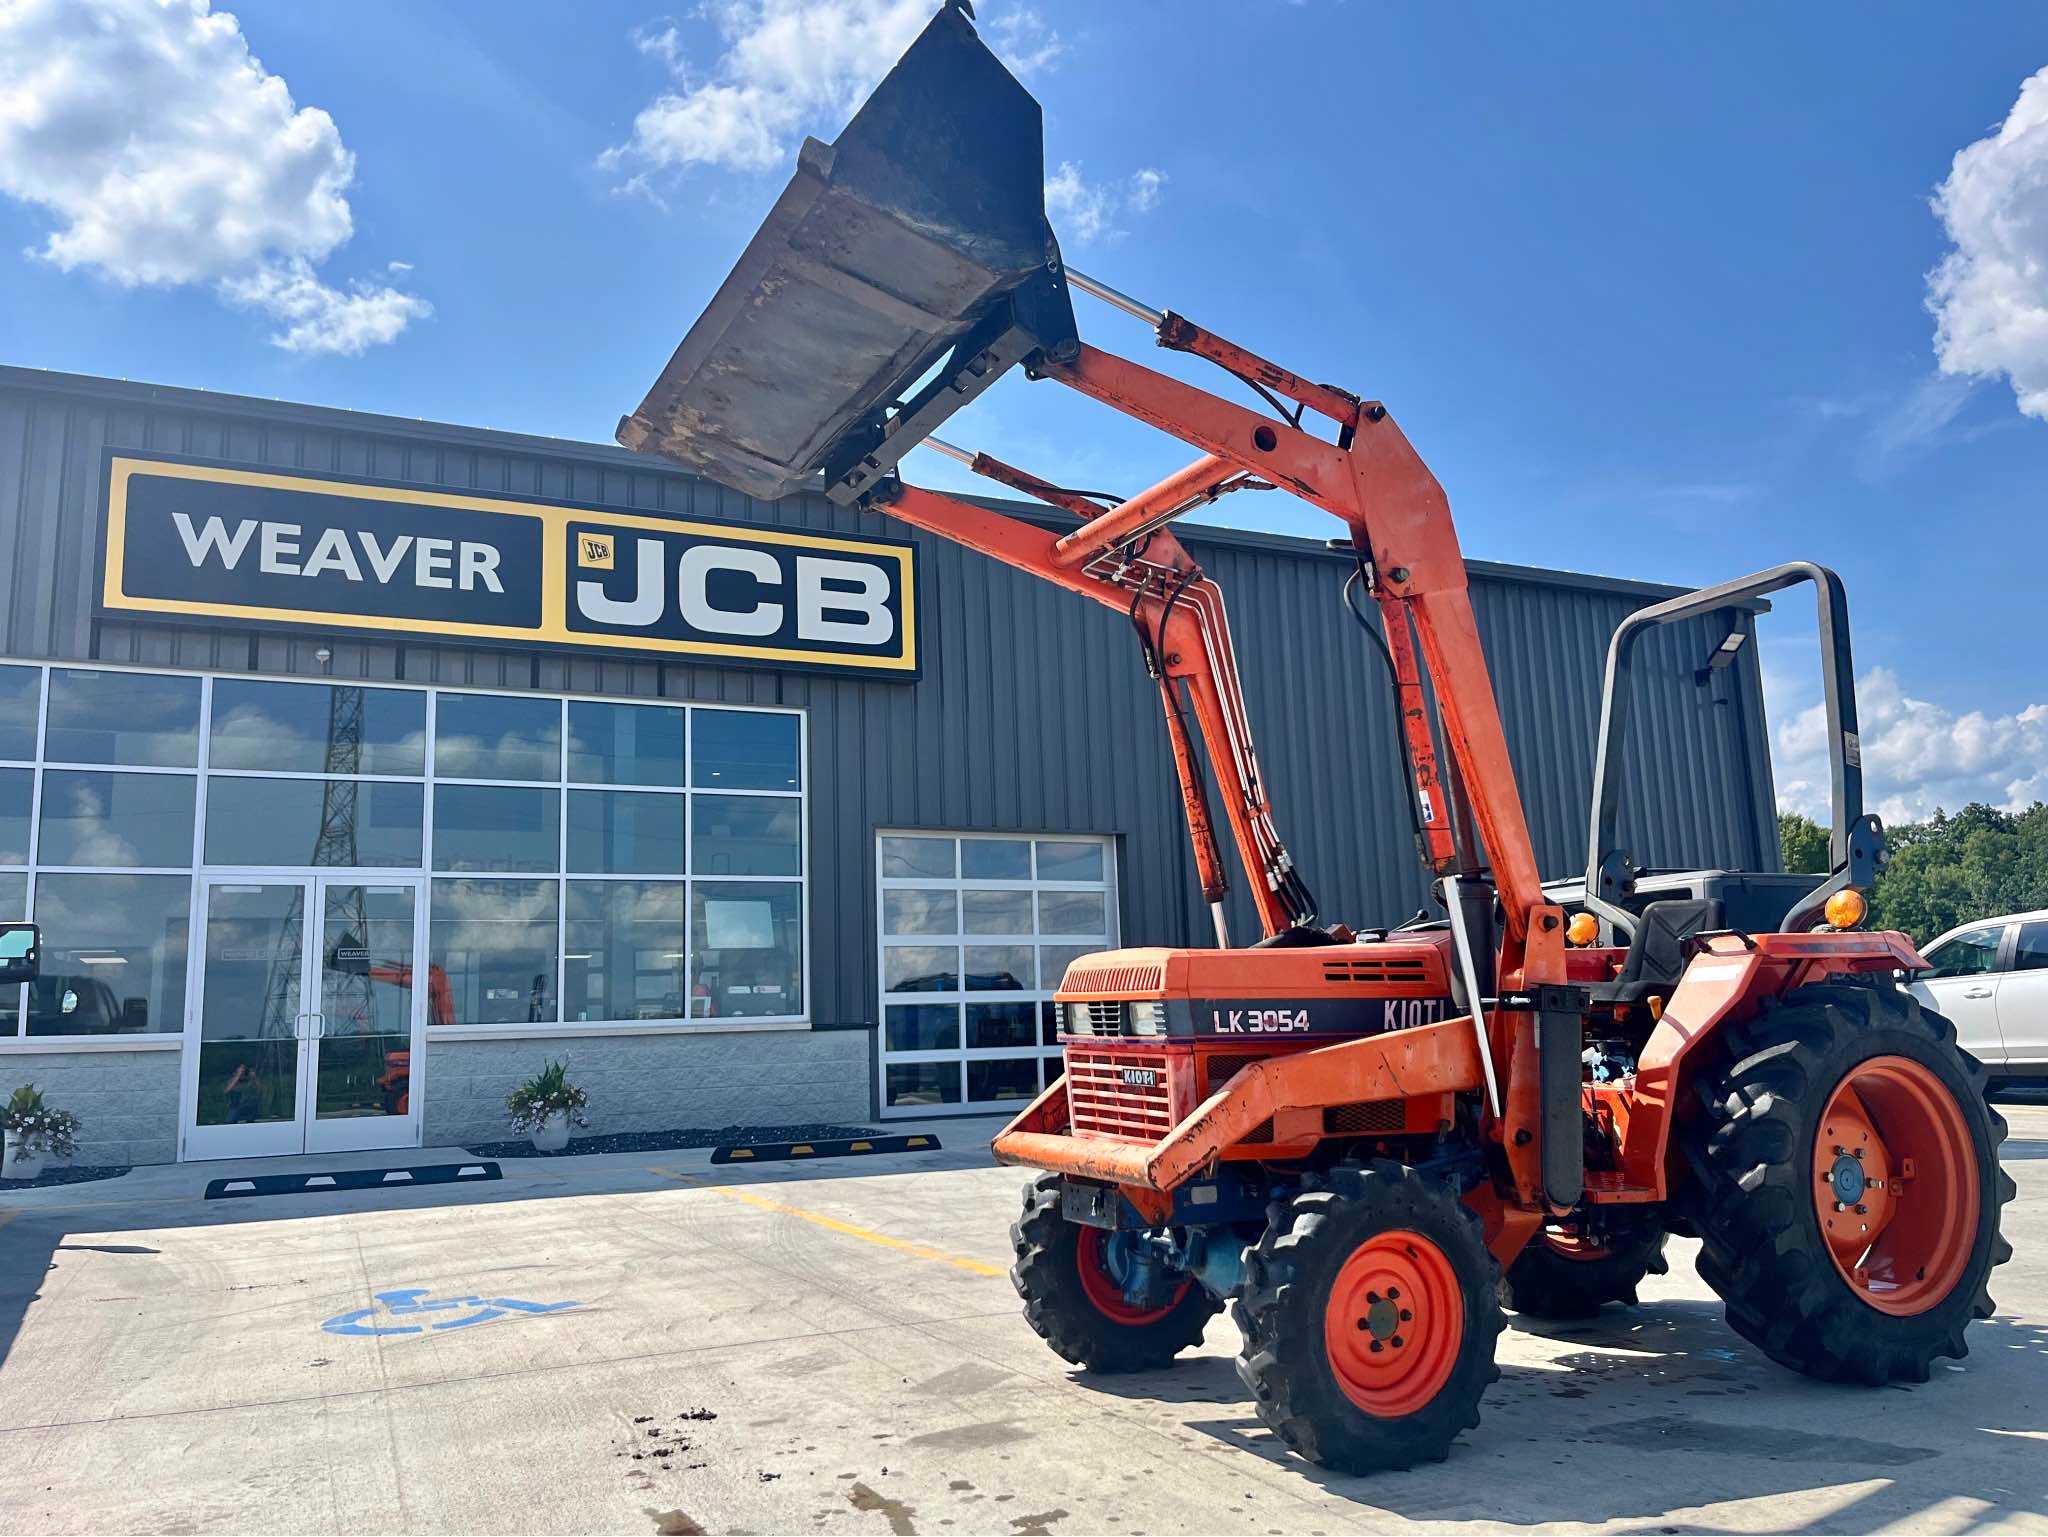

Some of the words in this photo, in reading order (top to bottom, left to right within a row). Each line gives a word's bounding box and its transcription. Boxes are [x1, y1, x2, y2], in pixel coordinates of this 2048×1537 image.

[171, 512, 504, 593] WEAVER
[586, 541, 609, 559] JCB
[576, 539, 893, 645] JCB
[1213, 1009, 1243, 1033] LK
[1248, 1009, 1309, 1033] 3054
[1384, 999, 1445, 1030] KIOTI
[1123, 1069, 1154, 1085] KIOTI
